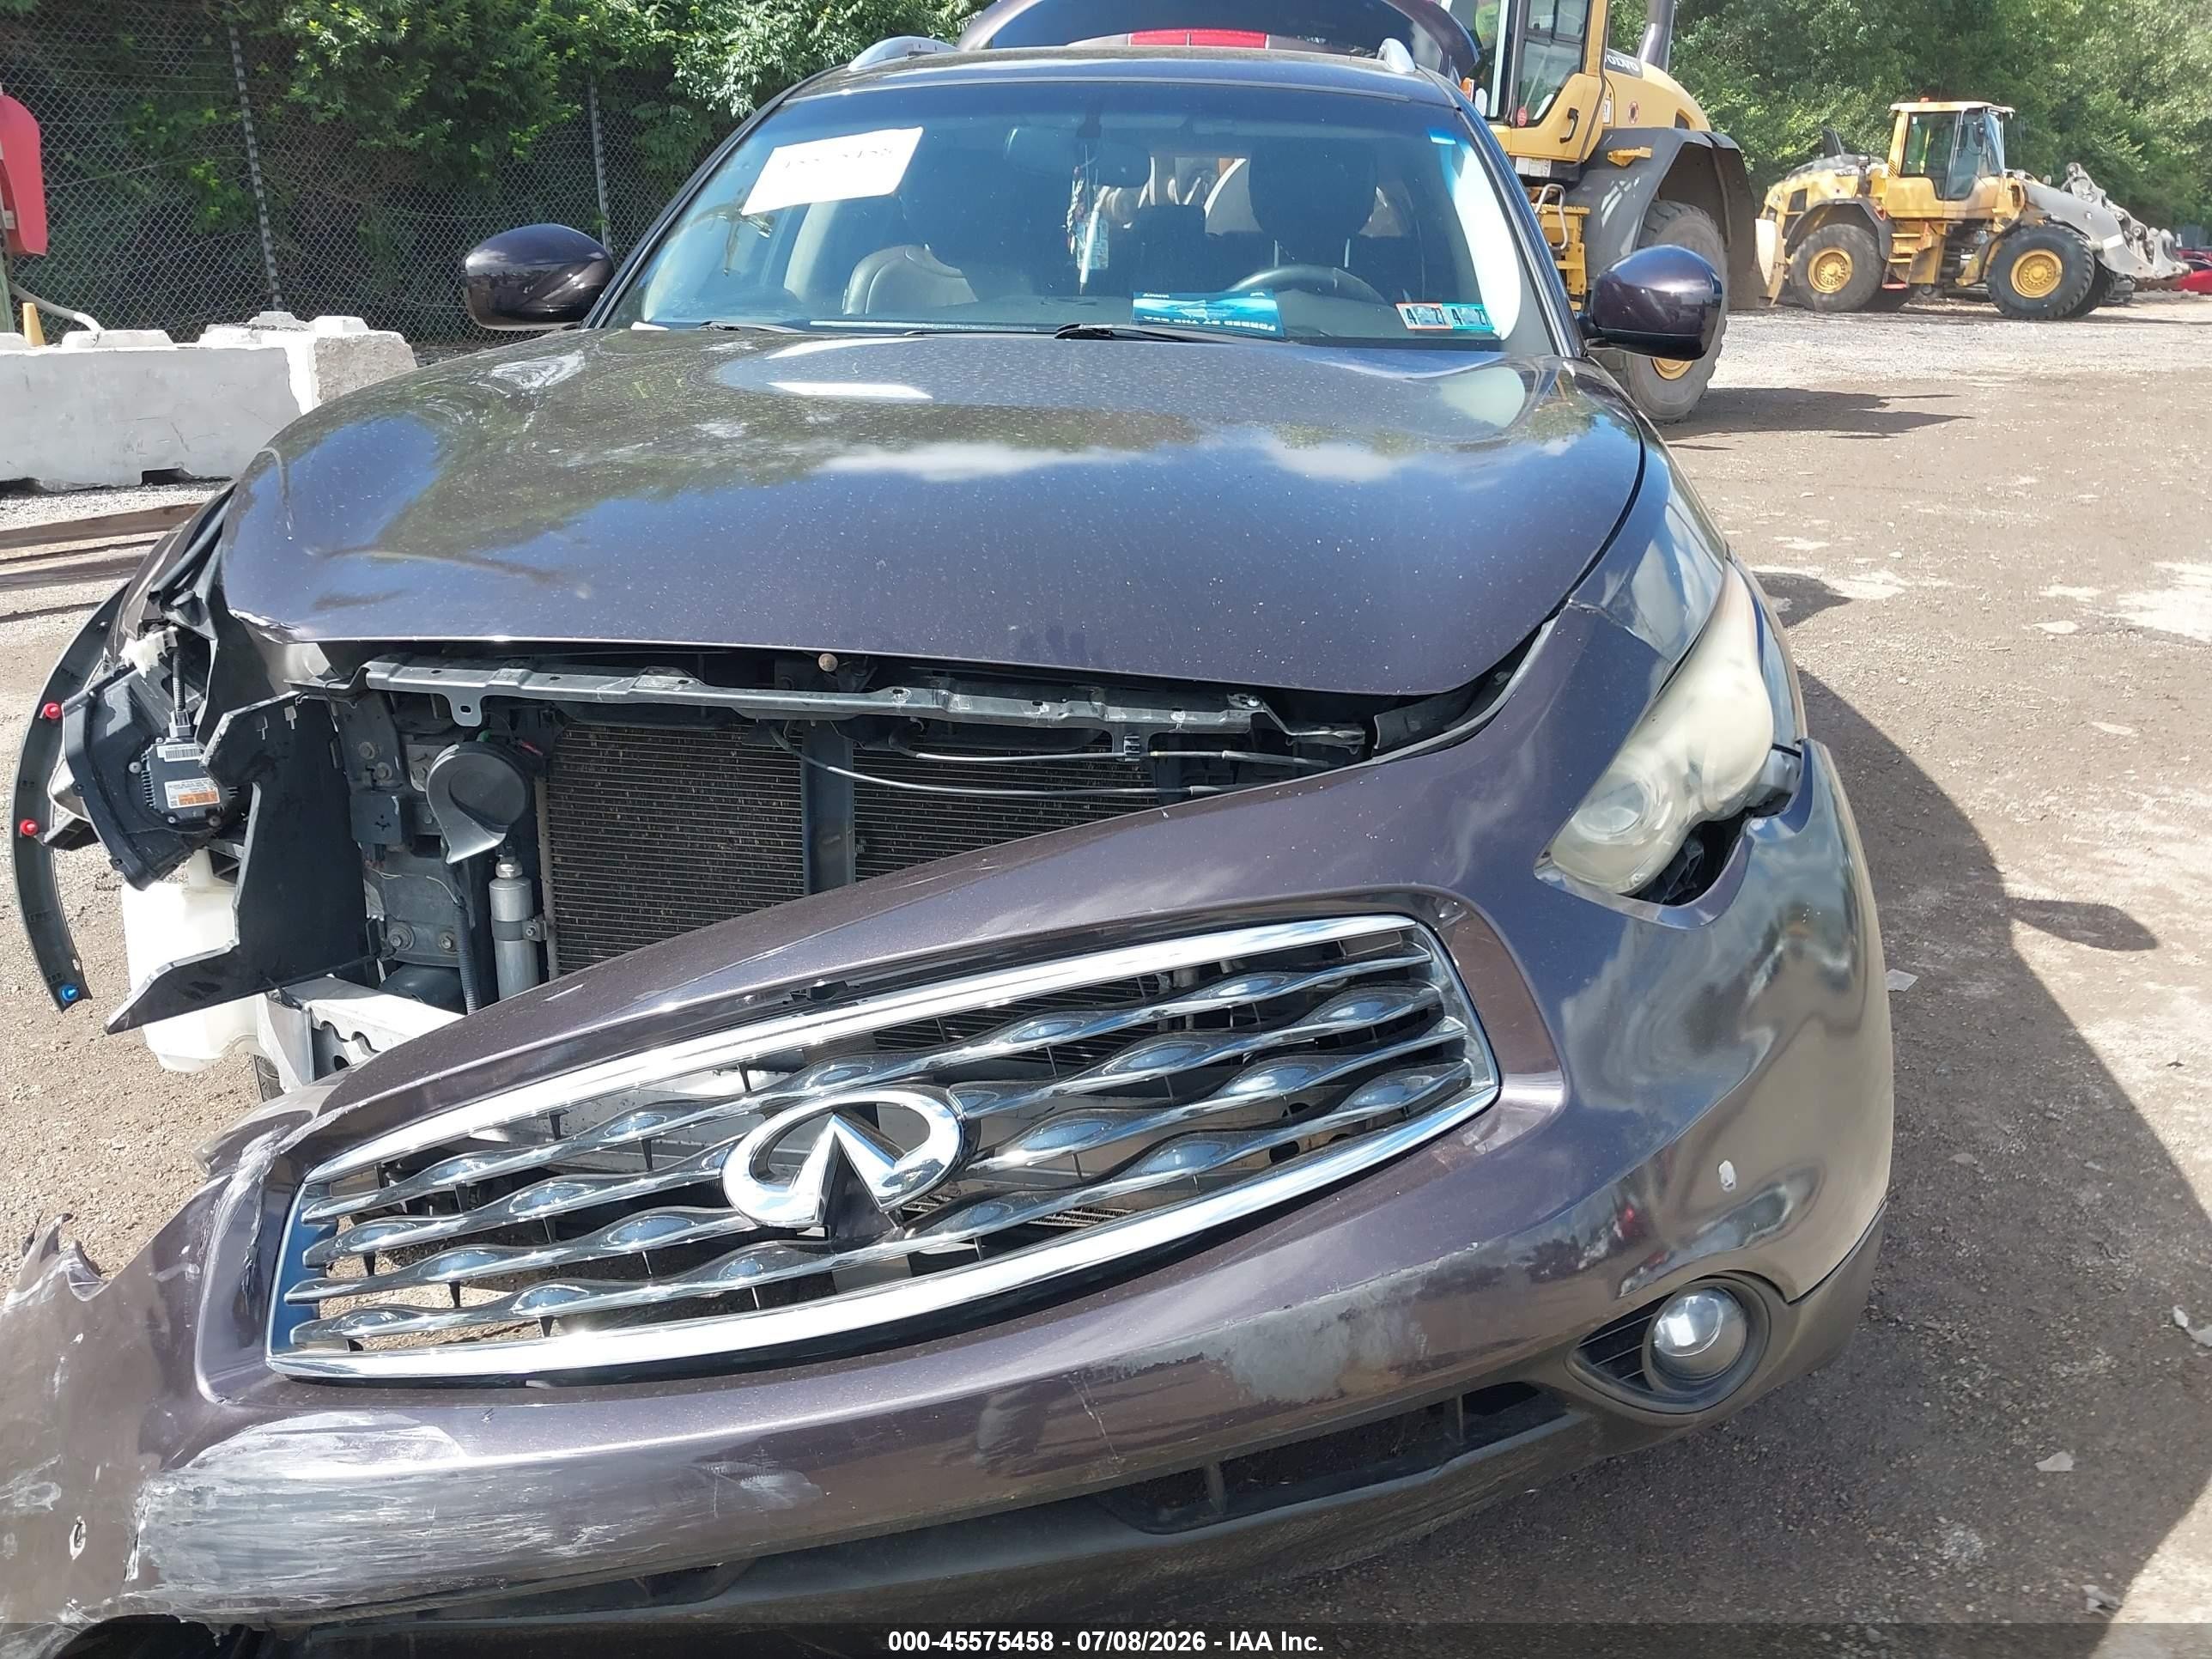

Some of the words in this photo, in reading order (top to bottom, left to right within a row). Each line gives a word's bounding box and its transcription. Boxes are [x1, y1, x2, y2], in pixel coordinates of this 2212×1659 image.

[1606, 54, 1639, 71] OLVO
[1406, 308, 1418, 325] 4
[1451, 308, 1462, 325] 4
